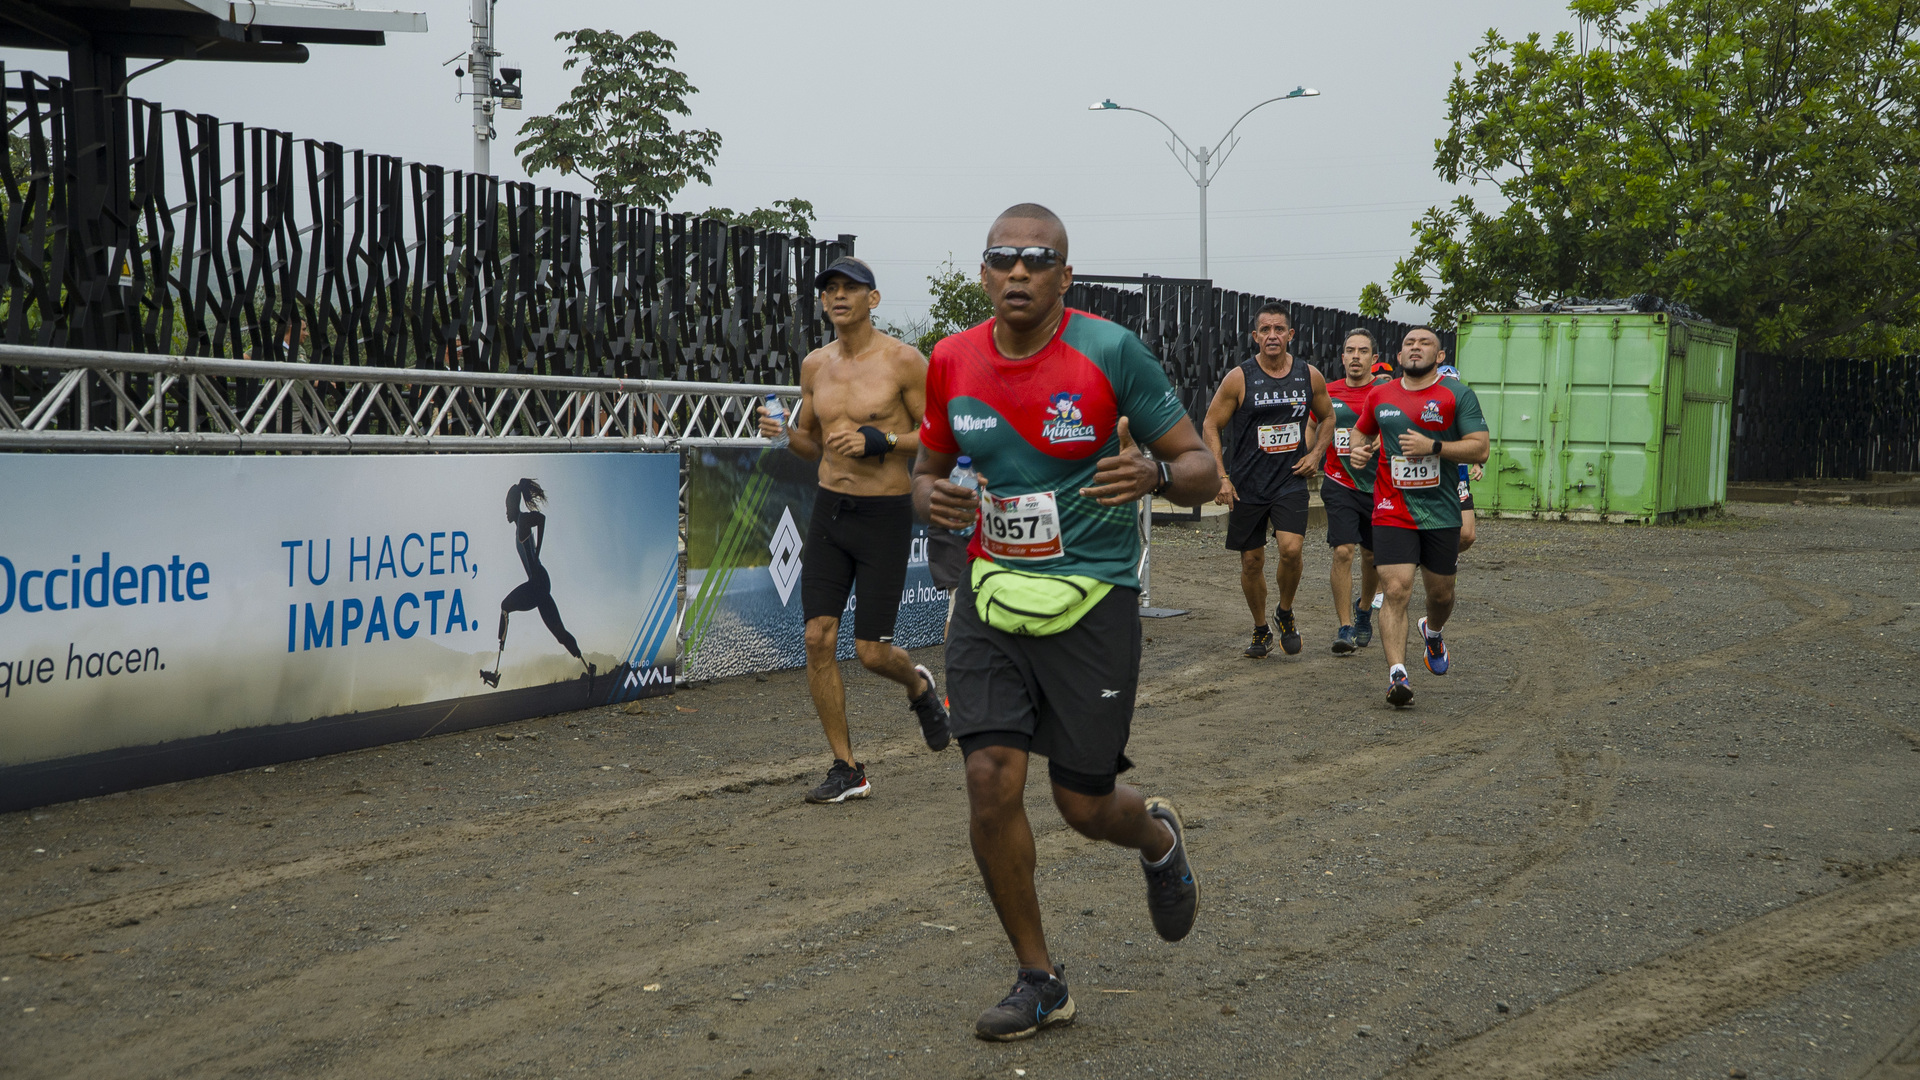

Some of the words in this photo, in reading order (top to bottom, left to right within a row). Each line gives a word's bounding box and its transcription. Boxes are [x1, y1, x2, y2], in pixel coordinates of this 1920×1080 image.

[1254, 389, 1306, 400] CARLOS
[1291, 405, 1306, 418] 72
[1041, 423, 1096, 441] Muñeca
[1269, 432, 1291, 445] 377
[1403, 466, 1428, 479] 219
[985, 512, 1040, 540] 1957
[281, 538, 331, 587] TU
[349, 530, 478, 582] HACER,
[899, 588, 915, 611] ue
[288, 588, 479, 653] IMPACTA.
[65, 642, 166, 680] hacen.
[630, 660, 650, 669] Grupo
[623, 665, 673, 689] AVAL
